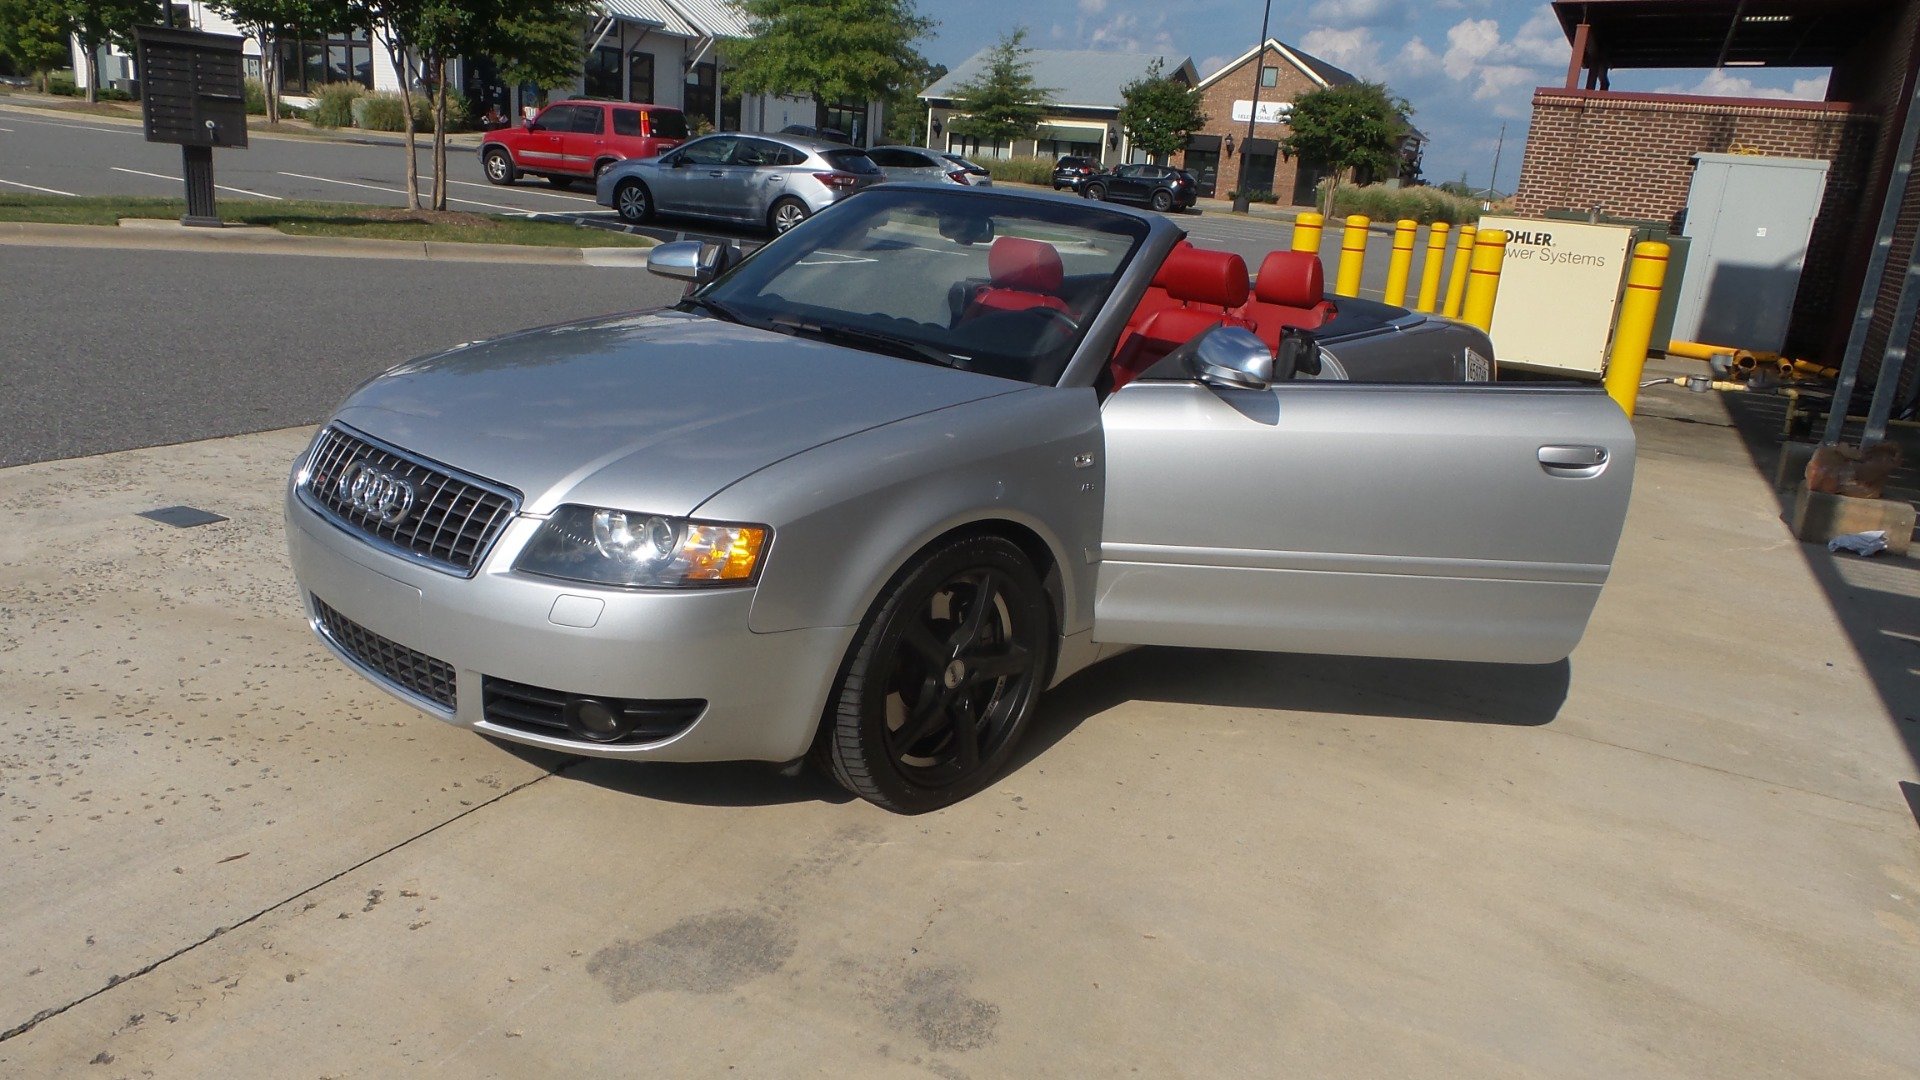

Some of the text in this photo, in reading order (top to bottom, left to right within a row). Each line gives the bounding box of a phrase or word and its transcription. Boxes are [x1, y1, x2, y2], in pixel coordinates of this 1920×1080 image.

[1504, 229, 1552, 246] OHLER
[1504, 247, 1605, 267] wer Systems
